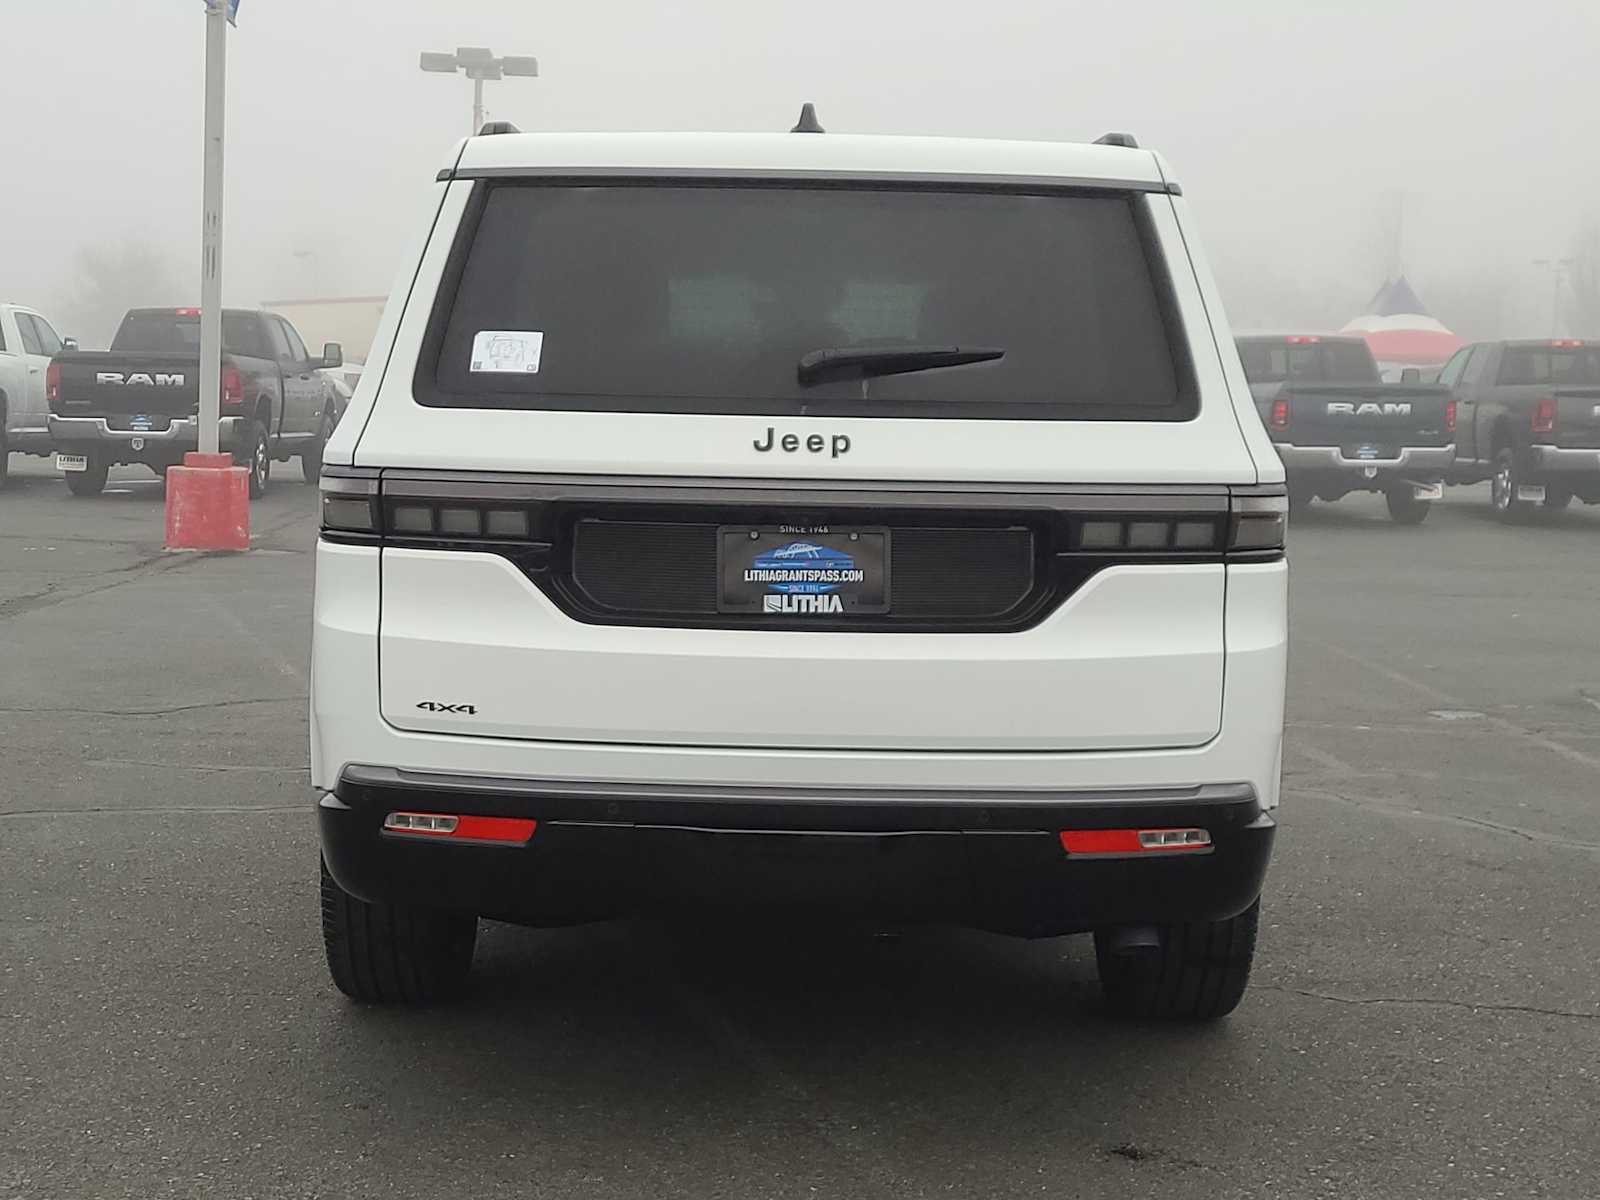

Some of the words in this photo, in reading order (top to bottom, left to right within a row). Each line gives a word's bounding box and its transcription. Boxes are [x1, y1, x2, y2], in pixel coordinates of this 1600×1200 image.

[96, 372, 185, 386] RAM
[1327, 402, 1412, 416] RAM
[753, 427, 851, 458] Jeep
[779, 524, 806, 534] SINCE
[744, 569, 864, 582] LITHIAGRANTSPASS.COM
[781, 594, 843, 612] LITHIA
[415, 701, 478, 715] 4x4
